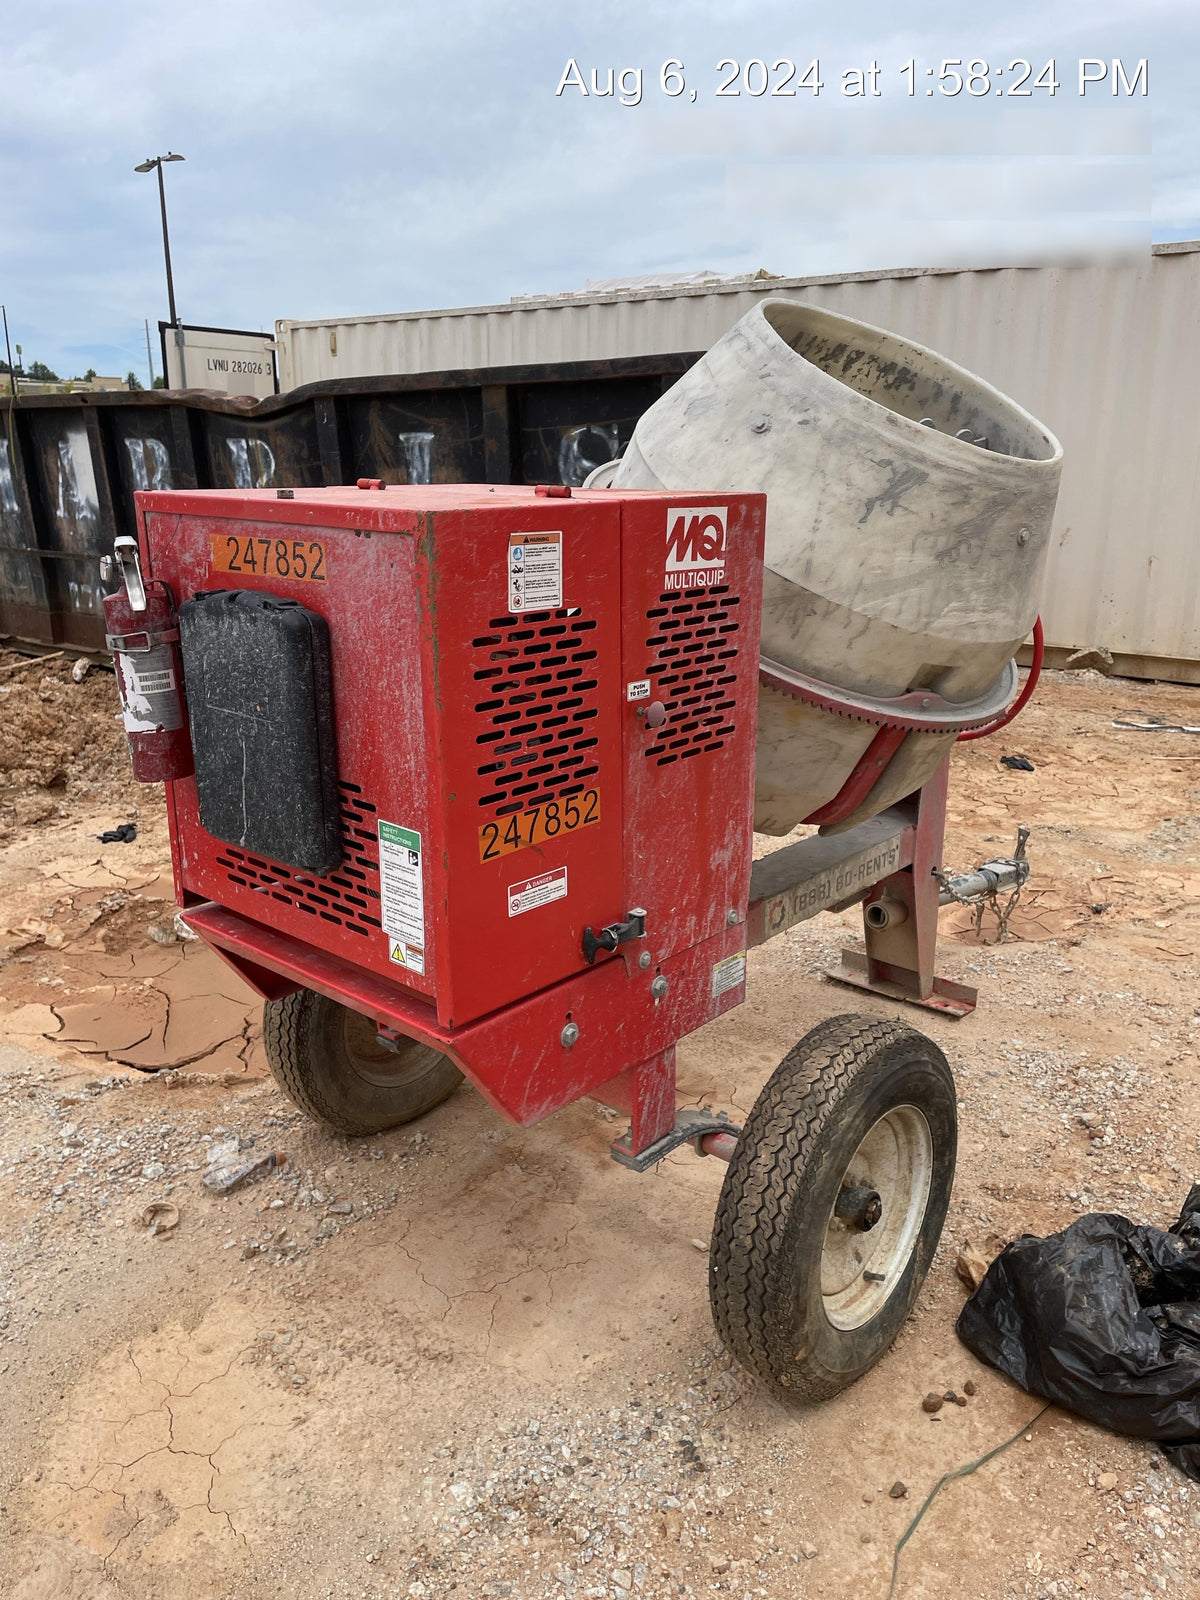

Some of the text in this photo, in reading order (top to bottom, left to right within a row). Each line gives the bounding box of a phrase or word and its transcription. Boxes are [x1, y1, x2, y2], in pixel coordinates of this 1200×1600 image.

[207, 358, 272, 376] LVNU 282026 3
[665, 513, 726, 563] MQ
[226, 536, 326, 581] 247852
[664, 569, 725, 591] MULTIQUIP
[633, 683, 646, 691] PUSH
[382, 825, 399, 835] SAFETY
[482, 789, 599, 861] 247852
[382, 832, 412, 847] INSTRUCTIONS
[532, 875, 553, 888] DANGER
